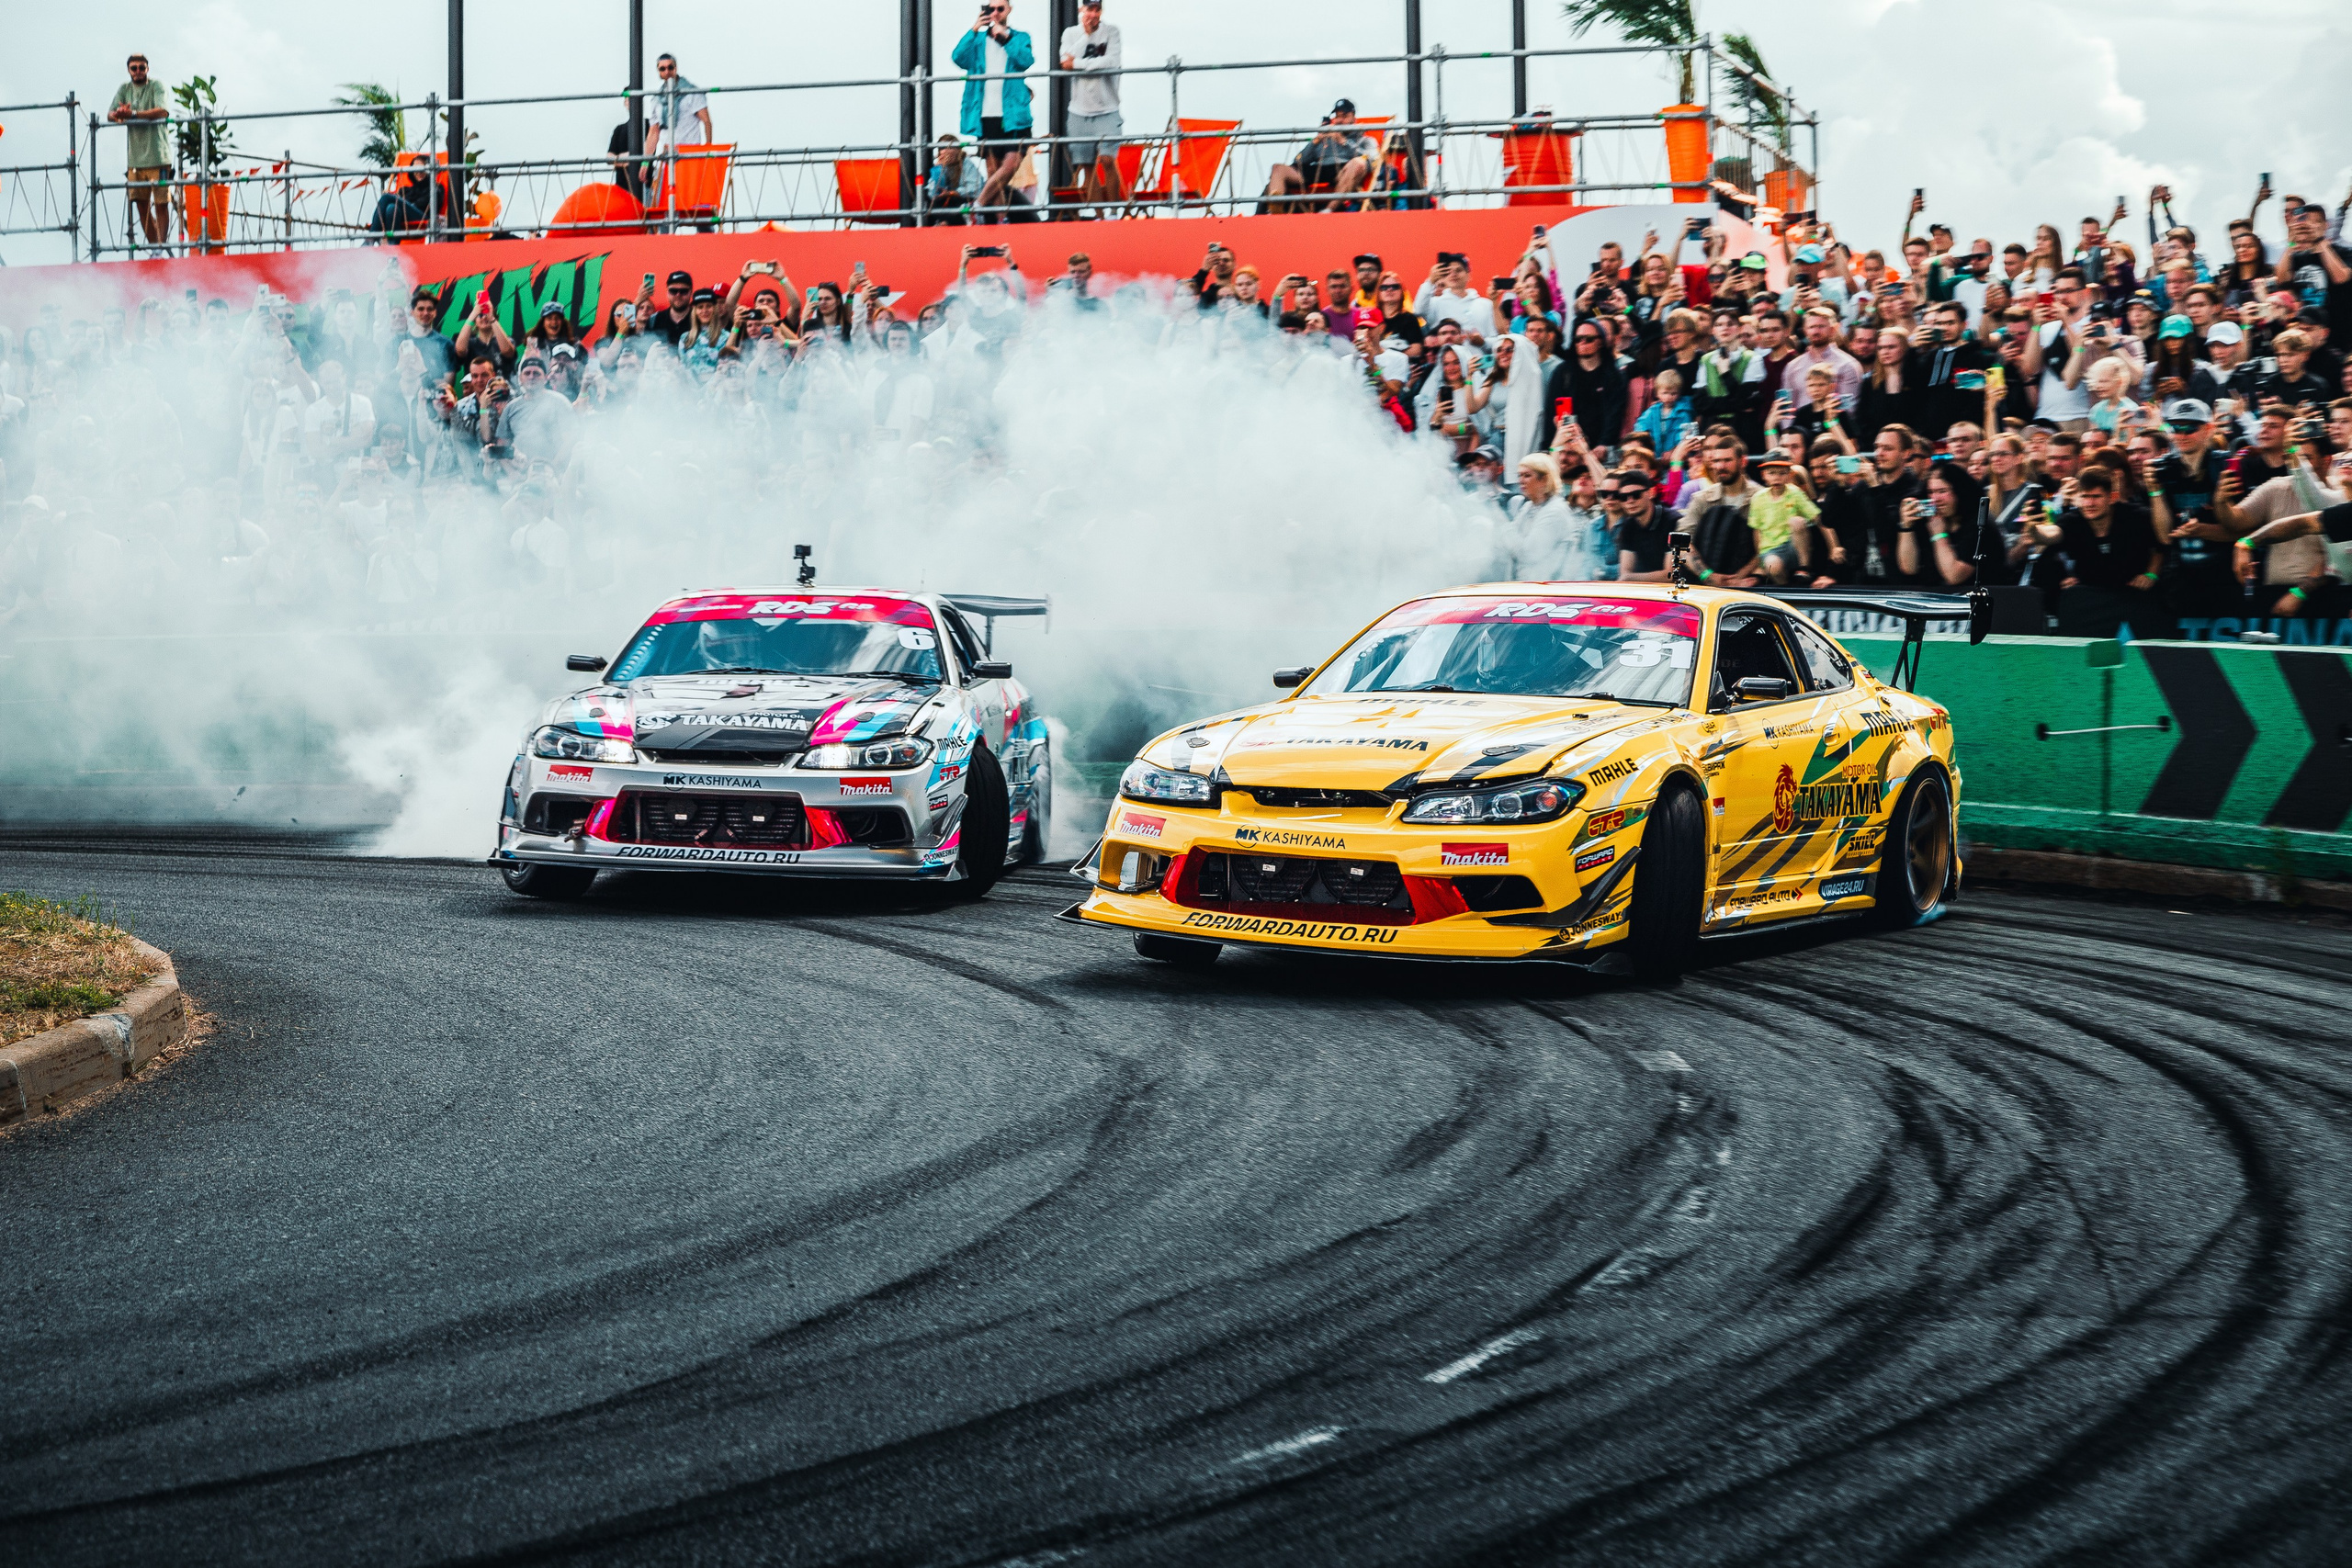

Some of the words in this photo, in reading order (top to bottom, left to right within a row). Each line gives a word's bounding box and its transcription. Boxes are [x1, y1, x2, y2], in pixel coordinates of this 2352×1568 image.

[747, 601, 840, 615] RDS
[1484, 603, 1595, 619] RDS
[1589, 605, 1636, 615] GP
[898, 627, 936, 650] 6
[1619, 639, 1694, 669] 31
[680, 715, 808, 731] TAKAYAMA
[1776, 723, 1815, 739] KASHIYAMA
[936, 736, 967, 750] MAHLE
[1286, 736, 1430, 752] TAKAYAMA
[1588, 757, 1639, 787] MAHLE
[1842, 765, 1865, 778] MOTOR
[1868, 763, 1877, 775] OIL
[662, 775, 686, 785] MK
[688, 775, 763, 789] KASHIYAMA
[1798, 782, 1883, 820] TAKAYAMA
[1588, 809, 1626, 837] GTR
[1235, 828, 1261, 842] MK
[1262, 830, 1347, 851] KASHIYAMA
[1849, 833, 1875, 852] SKILL
[616, 846, 801, 864] FORWARDAUTO.RU
[1577, 848, 1614, 865] FORWARD
[1577, 855, 1612, 870] RACING
[1821, 879, 1865, 897] VIRAGE24.RU
[1730, 892, 1769, 909] FORWARD
[1769, 889, 1791, 904] AUTO
[1181, 911, 1399, 944] FORWARDAUTO.RU
[1570, 911, 1623, 936] JONNESWAY
